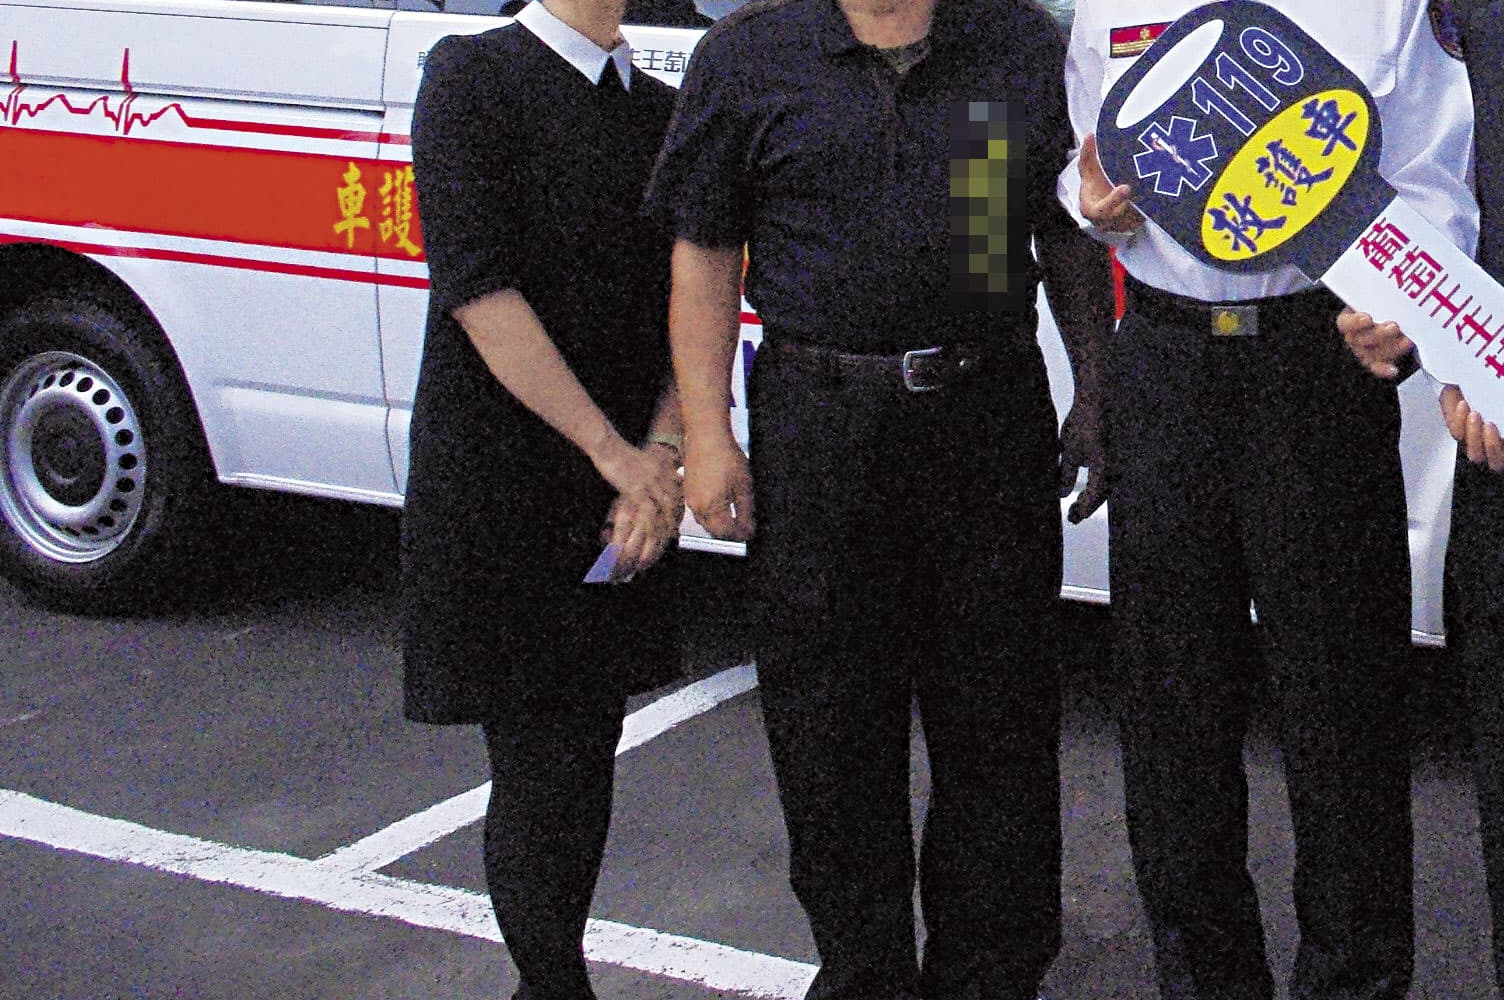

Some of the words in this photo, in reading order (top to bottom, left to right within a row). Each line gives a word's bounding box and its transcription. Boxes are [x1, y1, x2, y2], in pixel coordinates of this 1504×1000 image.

[1190, 26, 1305, 139] 119
[1205, 93, 1359, 254] 救護車
